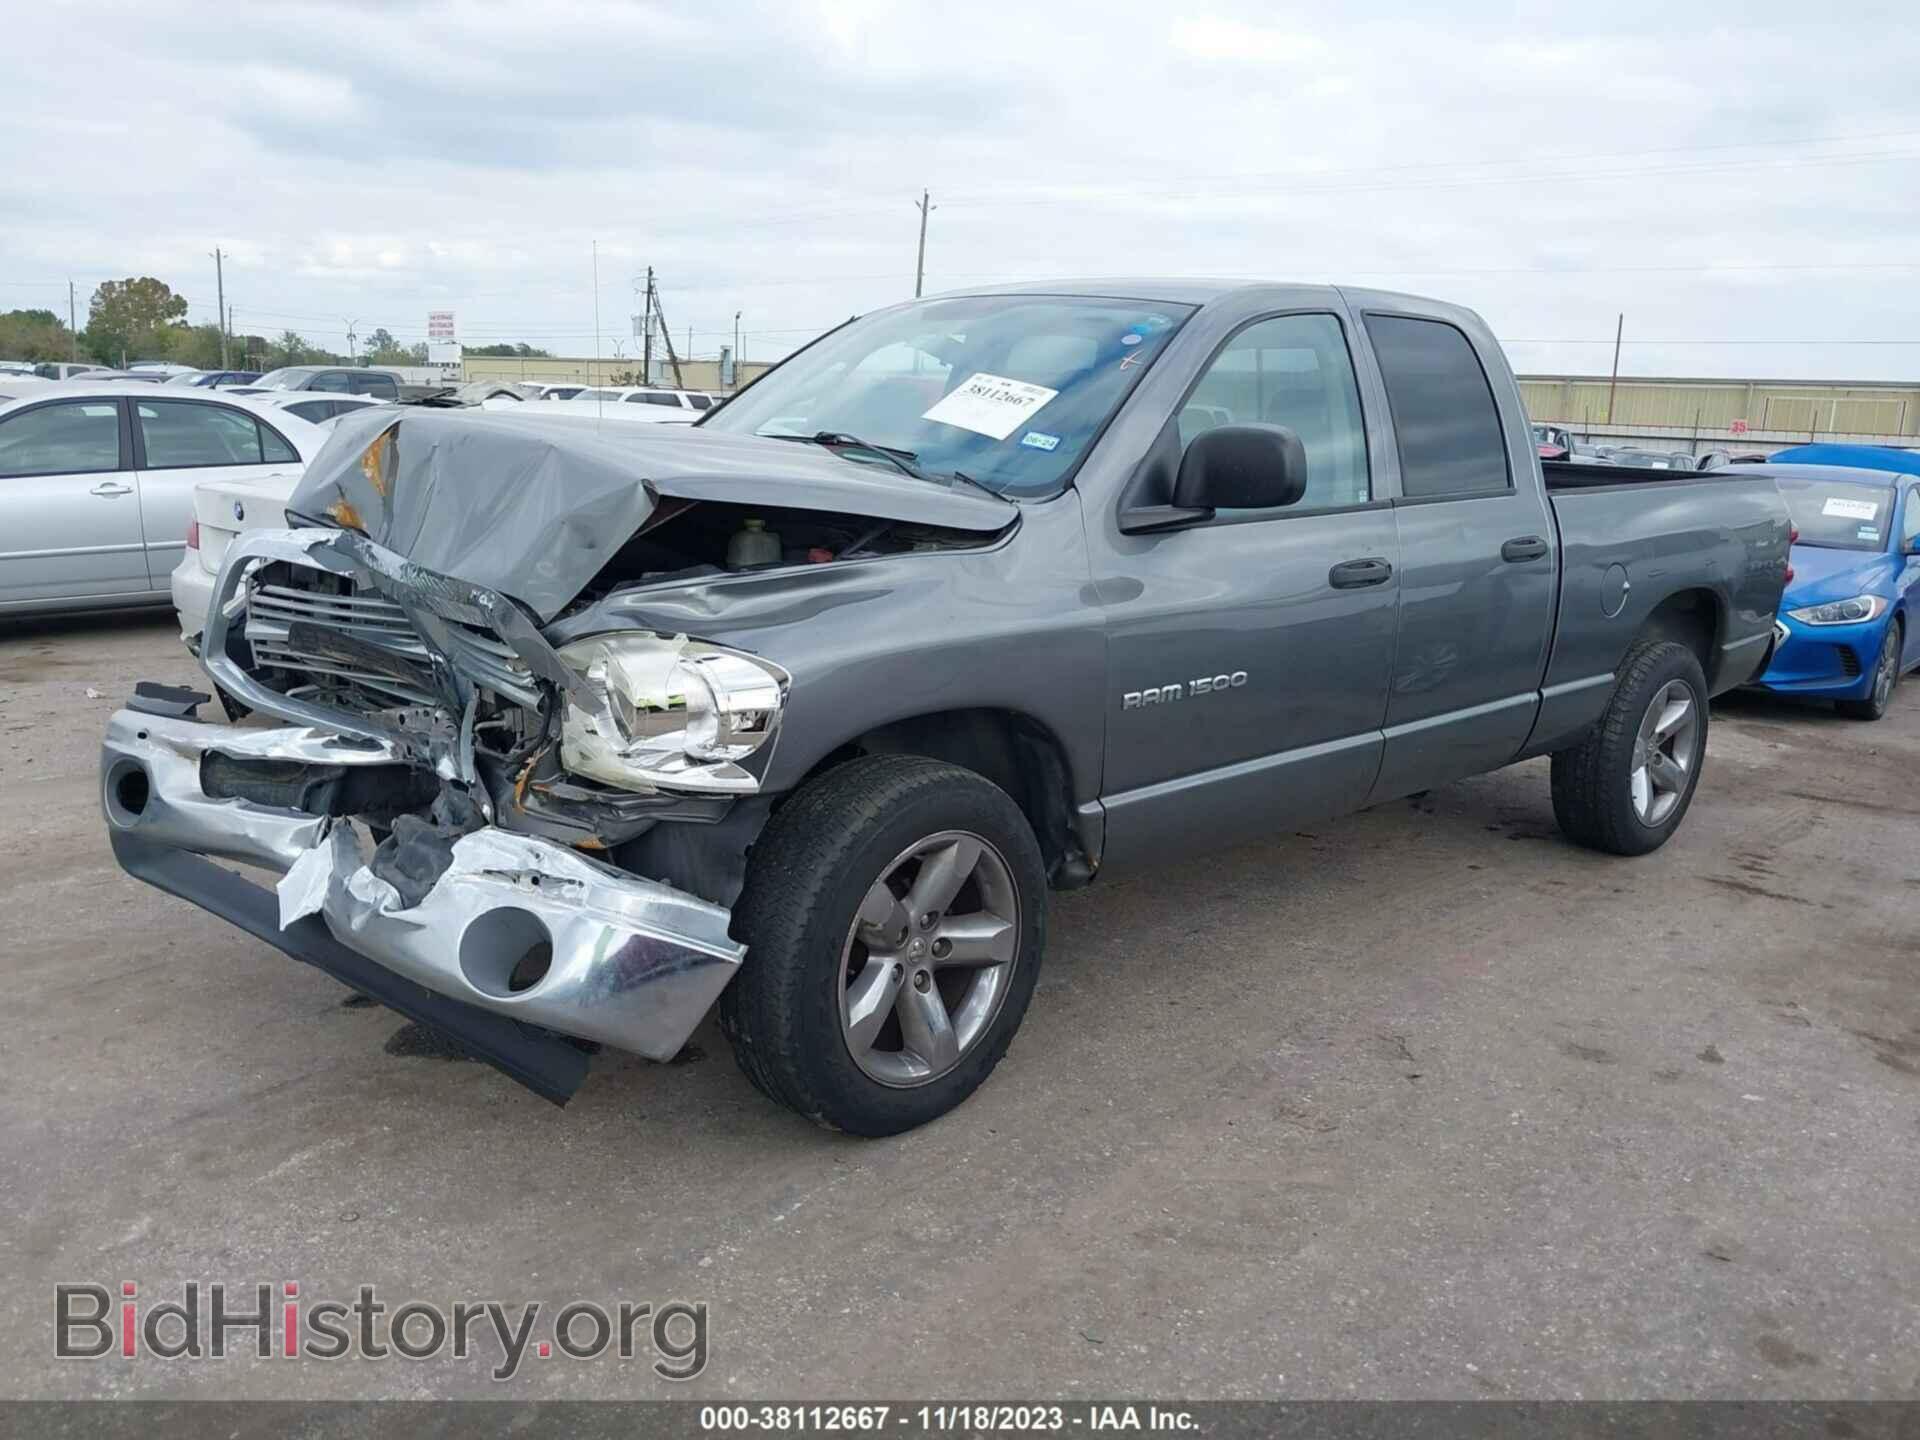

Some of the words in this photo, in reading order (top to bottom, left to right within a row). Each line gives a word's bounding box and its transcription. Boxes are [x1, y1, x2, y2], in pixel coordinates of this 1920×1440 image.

[970, 384, 1036, 406] 38112667
[1123, 684, 1182, 710] RAM
[1189, 671, 1248, 696] 1500
